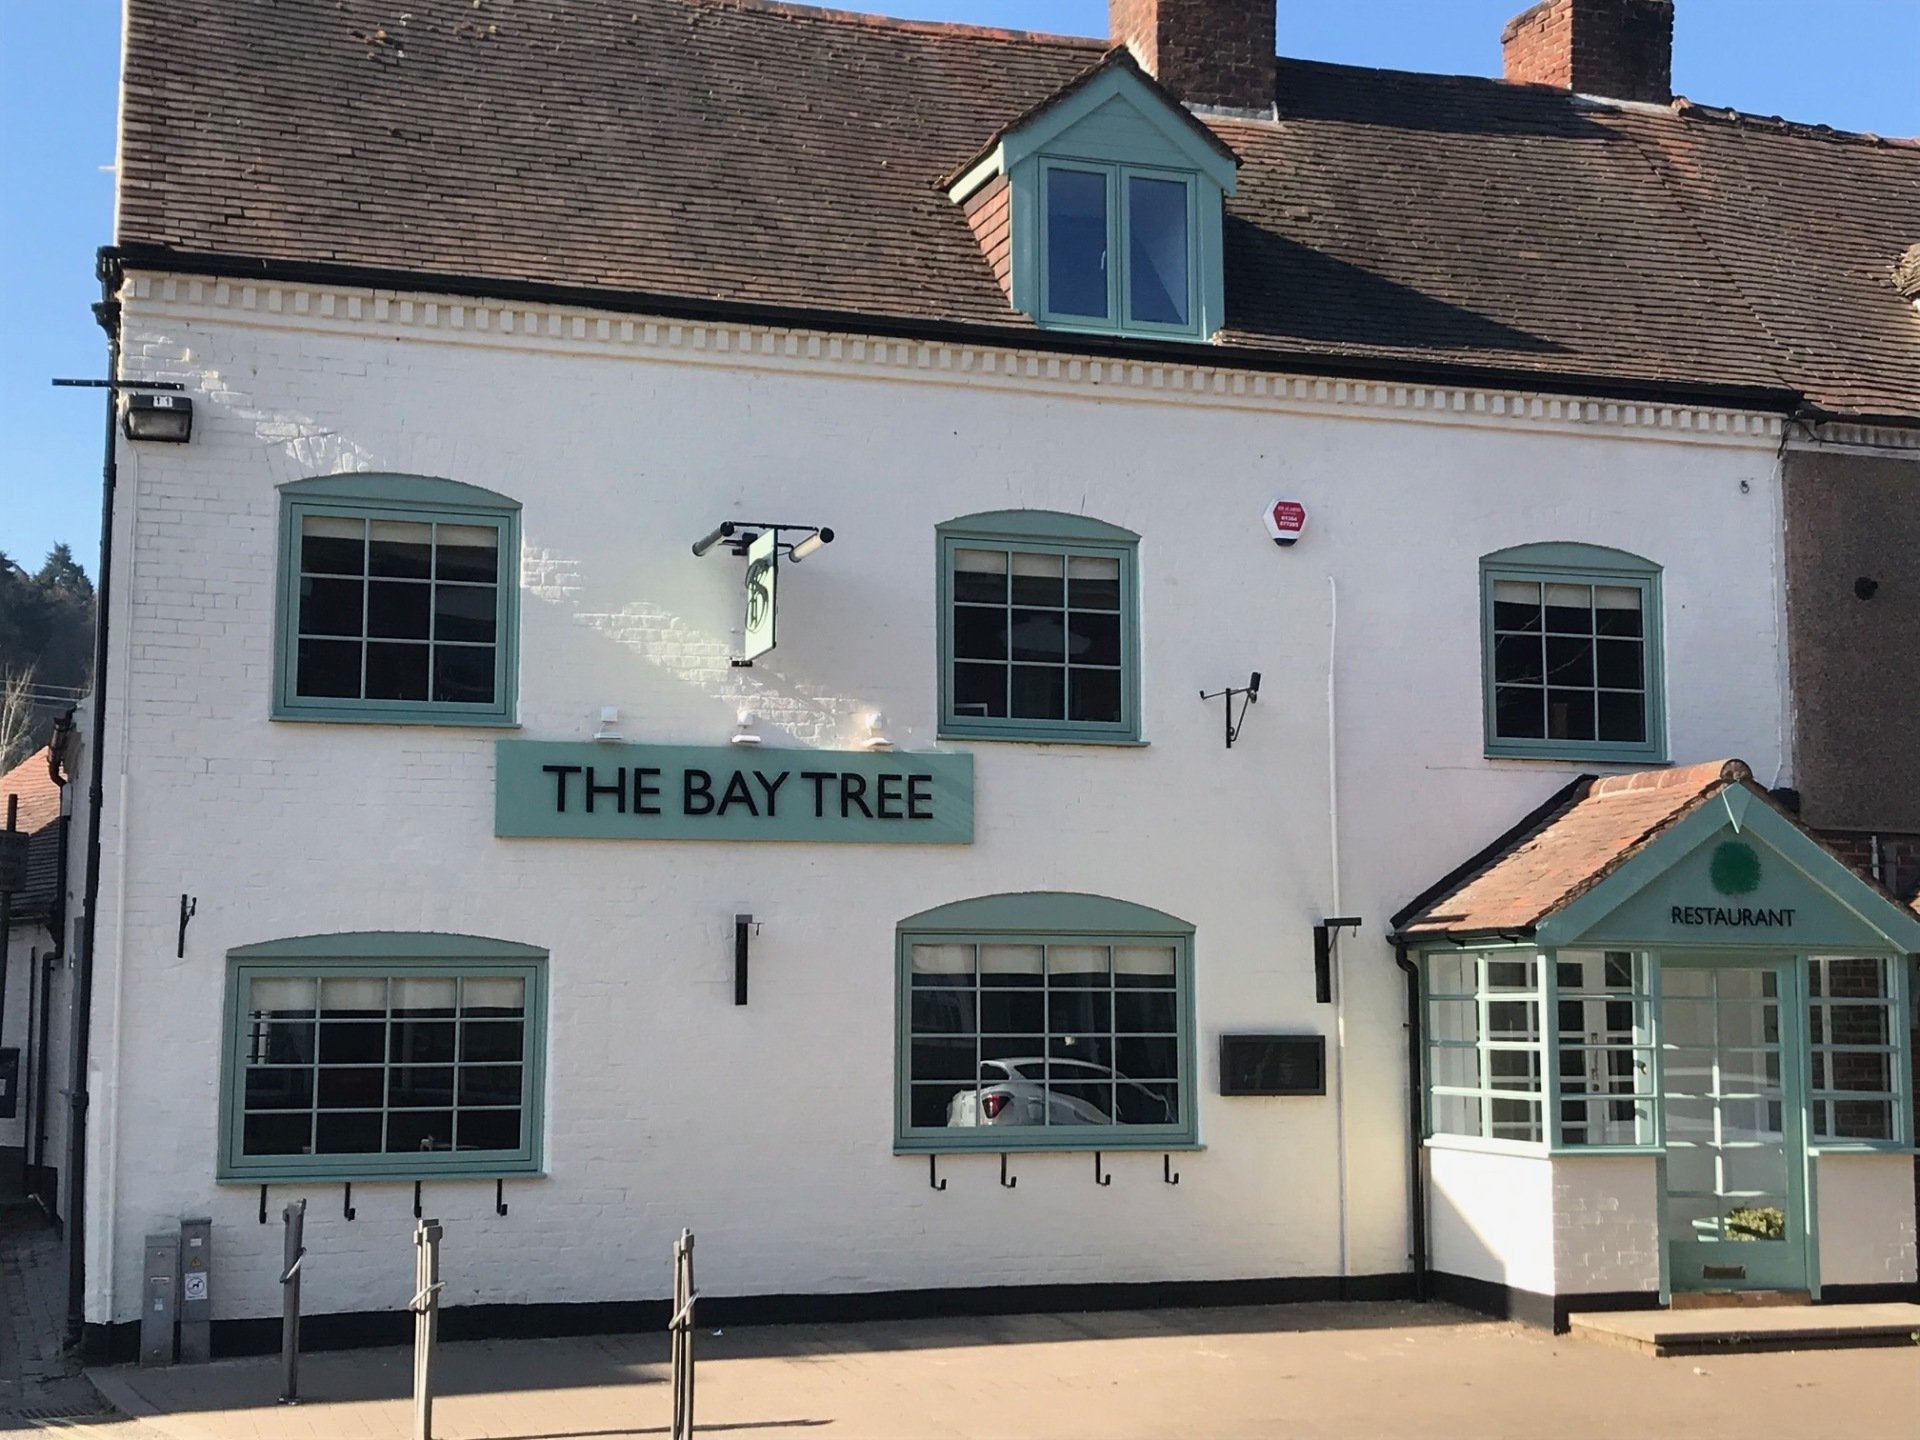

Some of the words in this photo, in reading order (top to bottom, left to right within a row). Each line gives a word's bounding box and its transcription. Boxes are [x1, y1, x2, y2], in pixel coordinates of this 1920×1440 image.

[542, 765, 662, 814] THE
[683, 769, 790, 817] BAY
[801, 772, 934, 820] TREE
[1671, 906, 1796, 927] RESTAURANT
